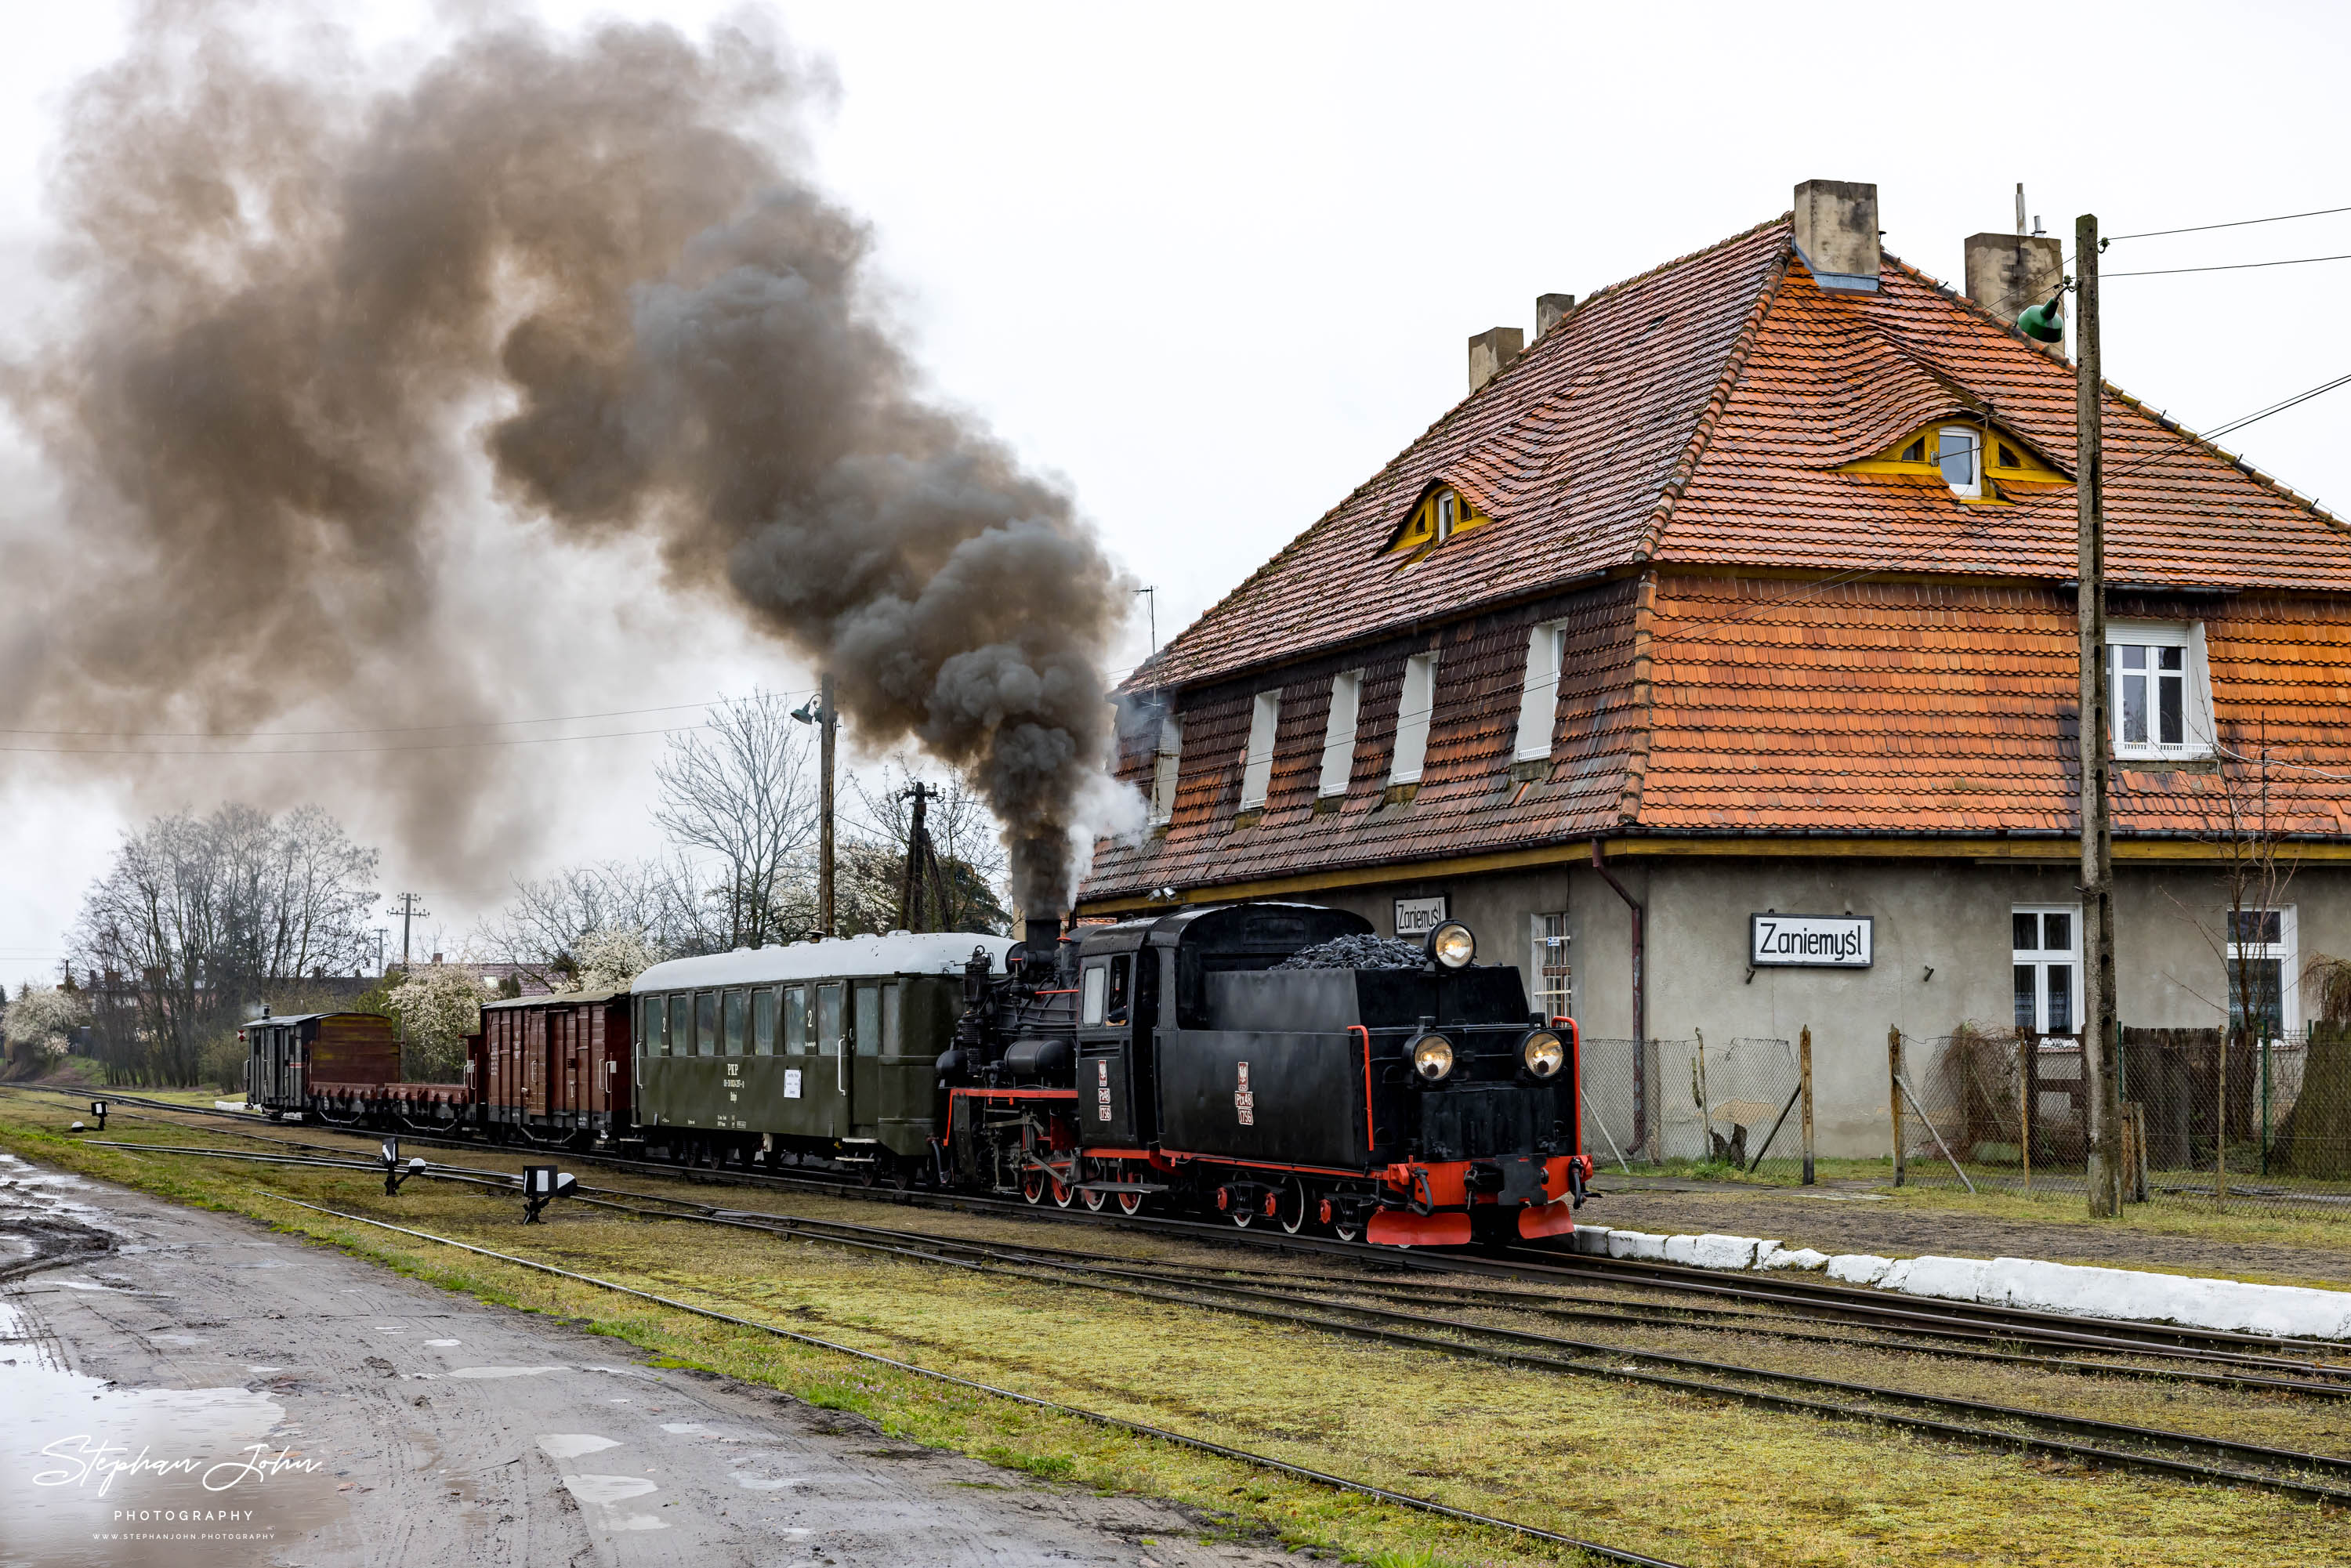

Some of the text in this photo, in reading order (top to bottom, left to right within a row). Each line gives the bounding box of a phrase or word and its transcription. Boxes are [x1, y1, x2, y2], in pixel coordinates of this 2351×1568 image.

[1760, 922, 1862, 961] Zaniemyśl
[807, 1009, 813, 1027] 2
[727, 1063, 739, 1076] PKP
[1239, 1110, 1252, 1123] 1756
